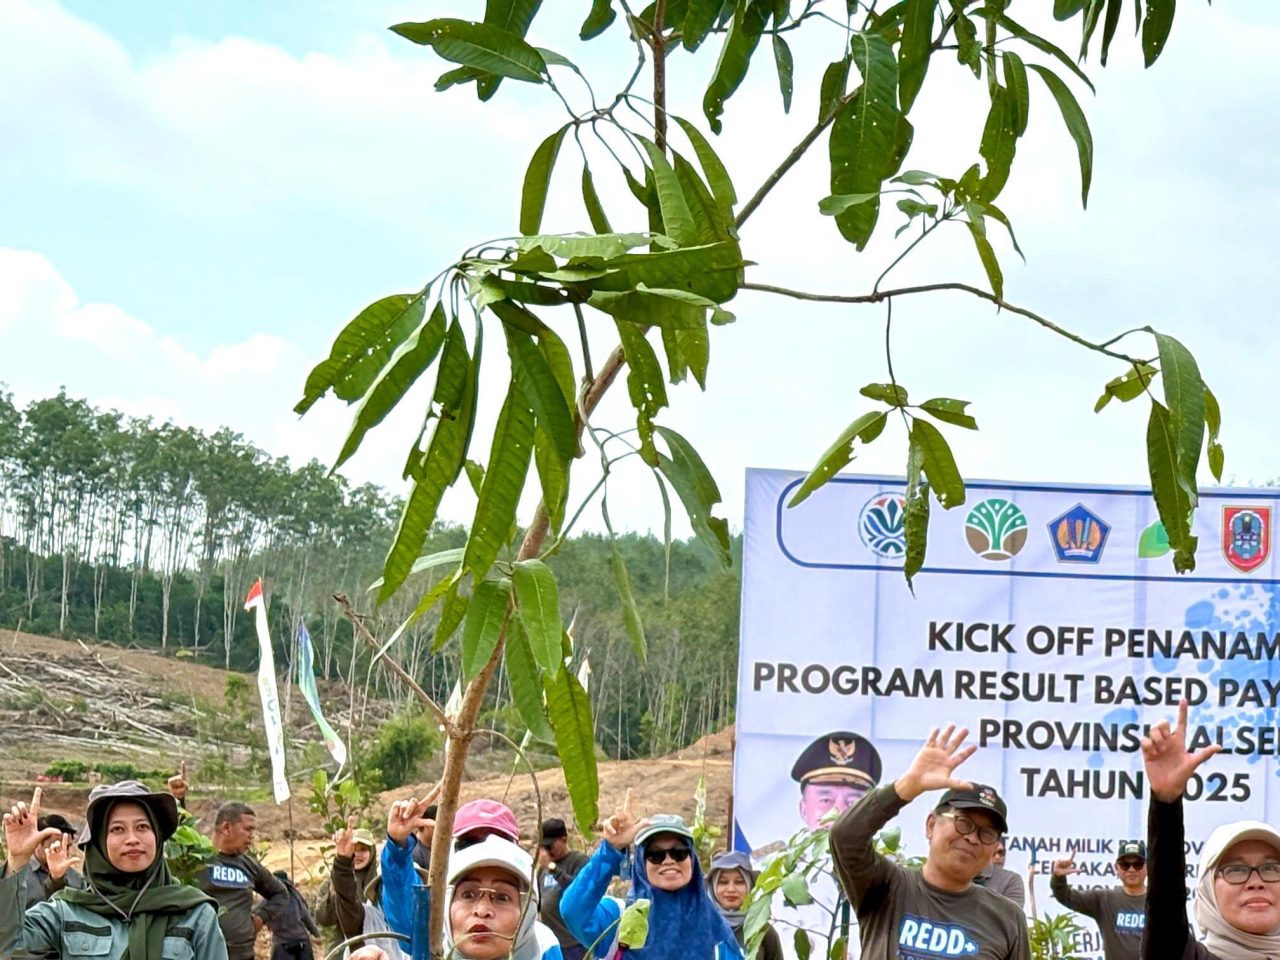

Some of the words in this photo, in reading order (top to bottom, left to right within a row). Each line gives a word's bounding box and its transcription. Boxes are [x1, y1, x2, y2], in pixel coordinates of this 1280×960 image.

[928, 621, 1017, 653] KICK
[1026, 625, 1094, 656] OFF
[753, 662, 943, 698] PROGRAM
[955, 670, 1084, 701] RESULT
[1095, 675, 1208, 706] BASED
[1020, 767, 1143, 800] TAHUN
[1183, 772, 1251, 802] 025
[1001, 836, 1061, 852] TANAH
[1065, 838, 1113, 853] MILIK
[899, 919, 976, 954] REDD+
